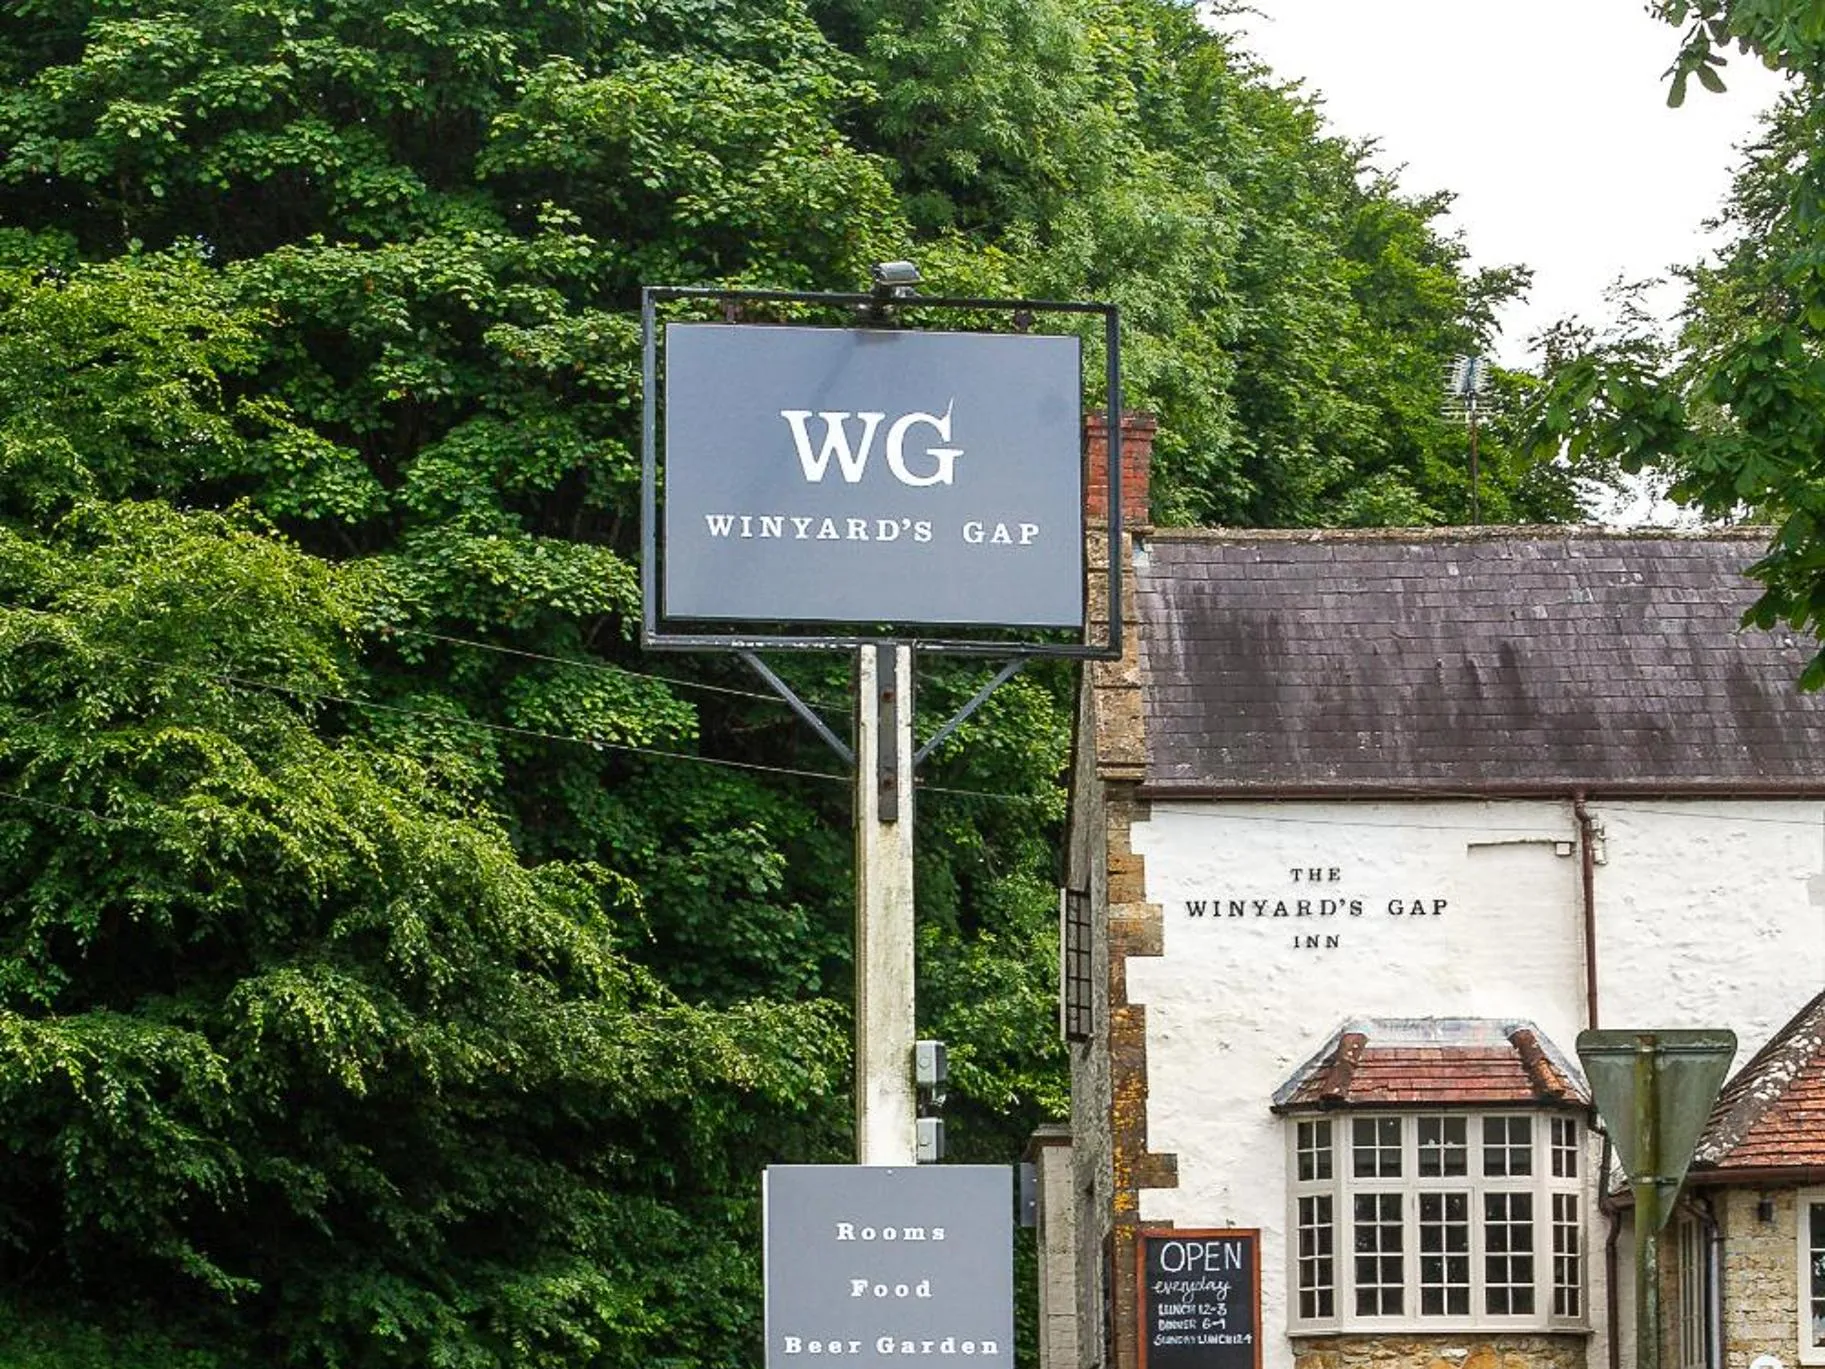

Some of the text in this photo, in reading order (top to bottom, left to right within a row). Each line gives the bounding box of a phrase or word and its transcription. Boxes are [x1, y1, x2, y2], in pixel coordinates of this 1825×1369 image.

[780, 396, 965, 487] WG
[704, 513, 1041, 546] WINYARD'S GAP
[1290, 867, 1342, 882] THE
[1185, 898, 1449, 918] WINYARD'S GAP
[1293, 934, 1341, 949] INN
[836, 1221, 946, 1241] Rooms
[1160, 1241, 1242, 1272] OPEN
[850, 1279, 933, 1298] Food
[1152, 1276, 1233, 1303] everyday
[1158, 1303, 1196, 1316] LUNCH
[1158, 1318, 1197, 1331] DINNER
[784, 1336, 999, 1355] Beer Garden
